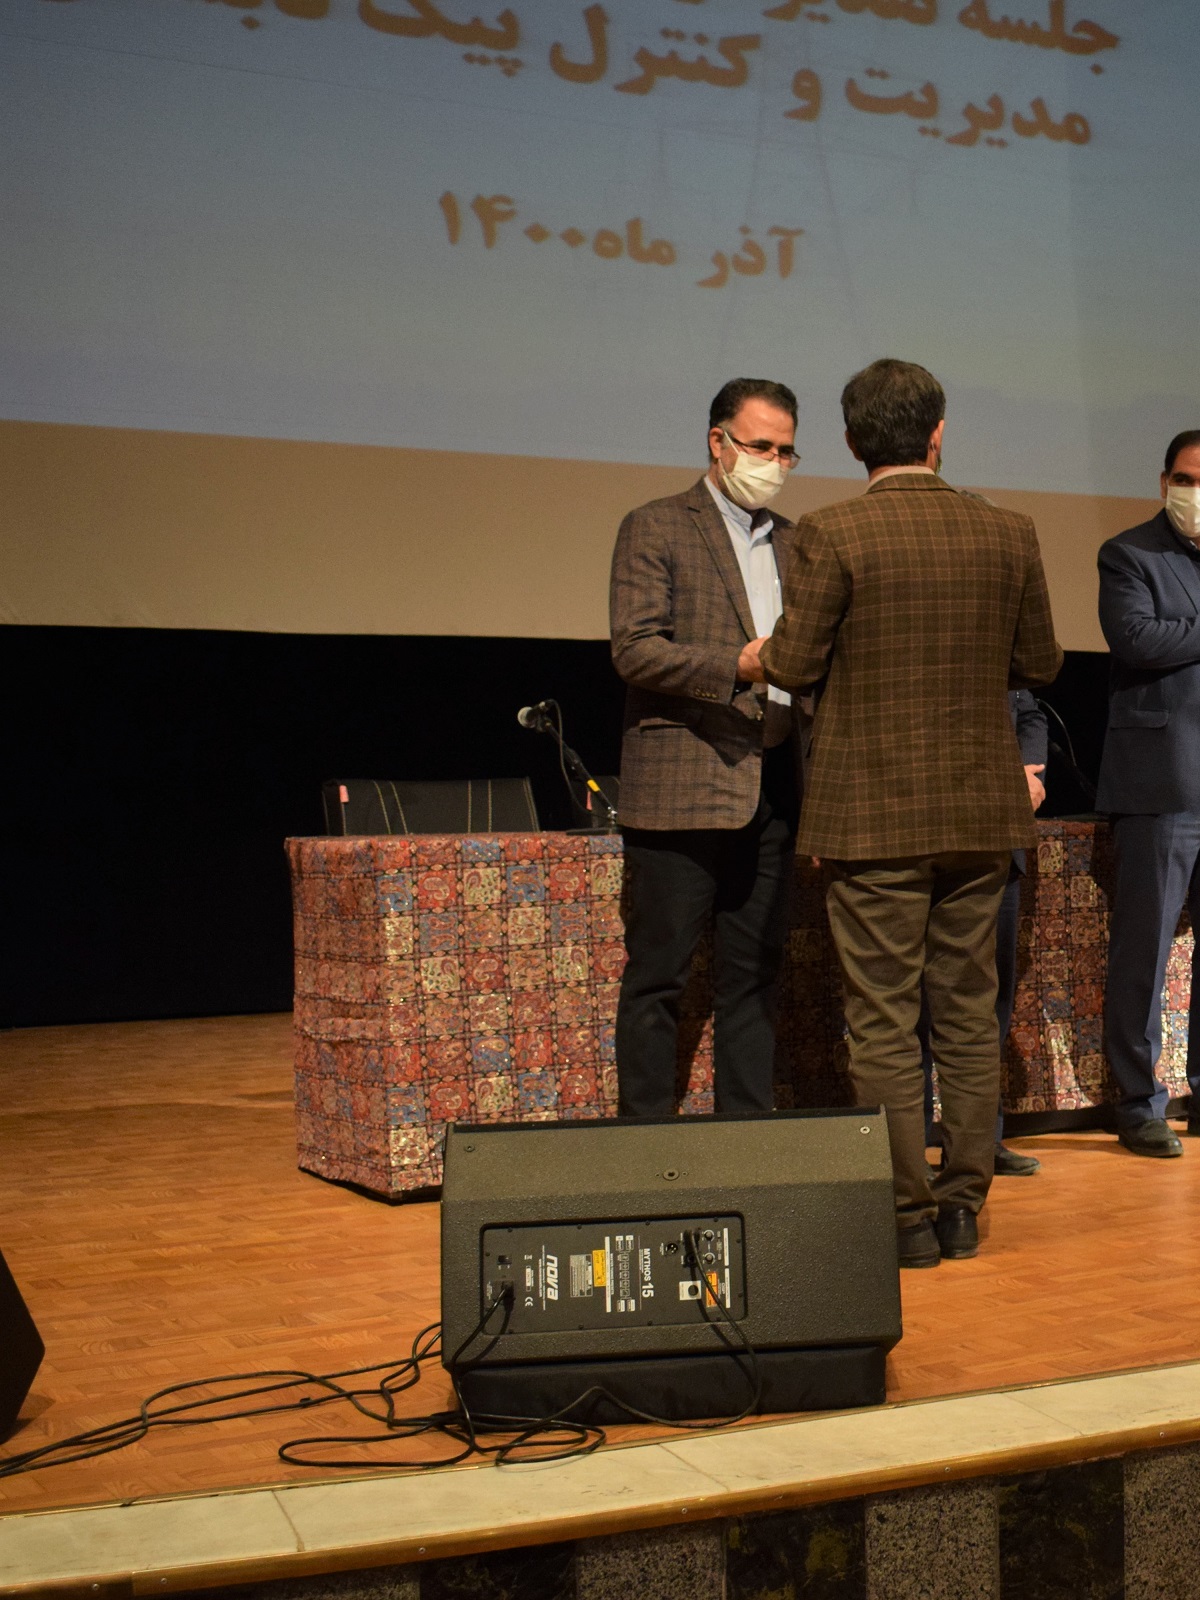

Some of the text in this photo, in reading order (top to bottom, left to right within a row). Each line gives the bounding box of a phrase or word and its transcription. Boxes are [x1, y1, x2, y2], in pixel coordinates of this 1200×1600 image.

[549, 4, 762, 96] کنترل
[783, 69, 823, 121] و
[845, 67, 1093, 149] مدیریت
[696, 225, 805, 289] آذر
[546, 1254, 558, 1301] nova
[642, 1248, 654, 1298] MYTHOS 15
